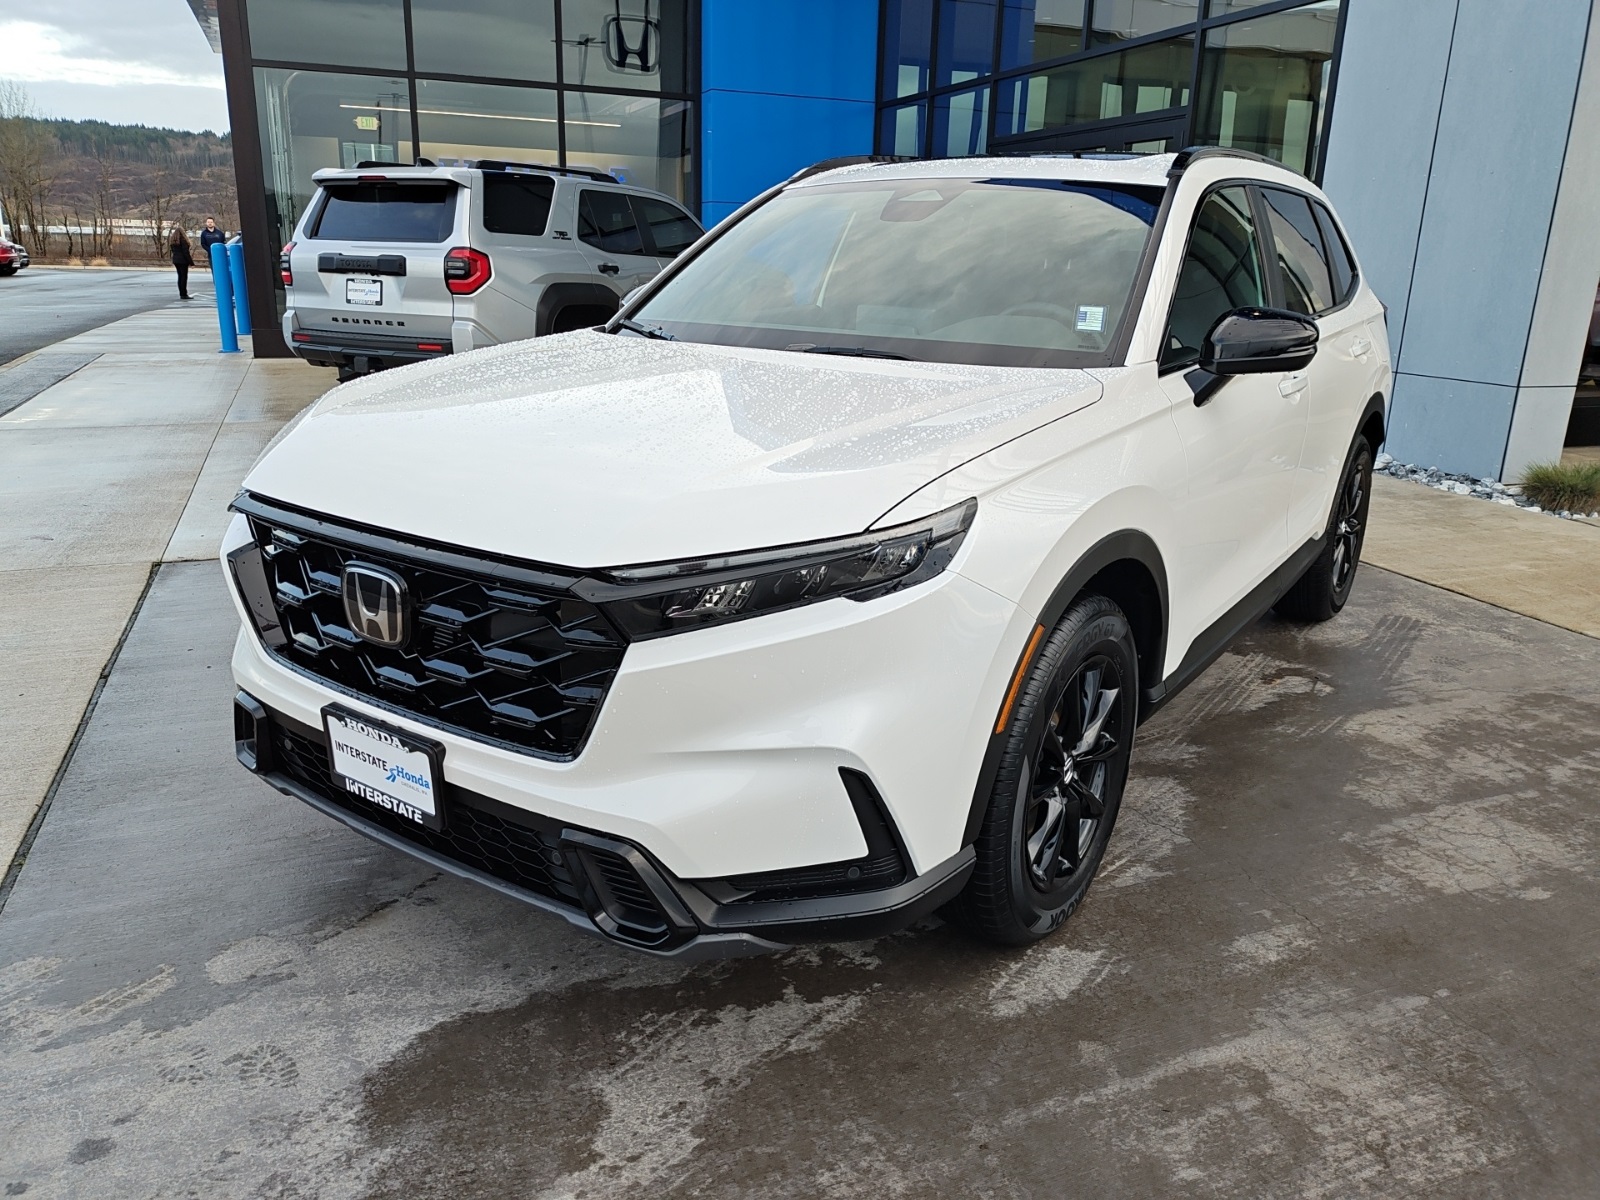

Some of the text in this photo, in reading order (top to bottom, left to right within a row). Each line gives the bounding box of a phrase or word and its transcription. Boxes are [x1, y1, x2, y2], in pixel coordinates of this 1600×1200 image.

[361, 117, 374, 129] EXIT
[340, 259, 372, 269] TOYOTA
[331, 317, 406, 327] 4RUNNER
[345, 717, 403, 750] HONDA
[334, 739, 431, 789] INTERSTATE Honda
[345, 777, 424, 825] INTERSTATE
